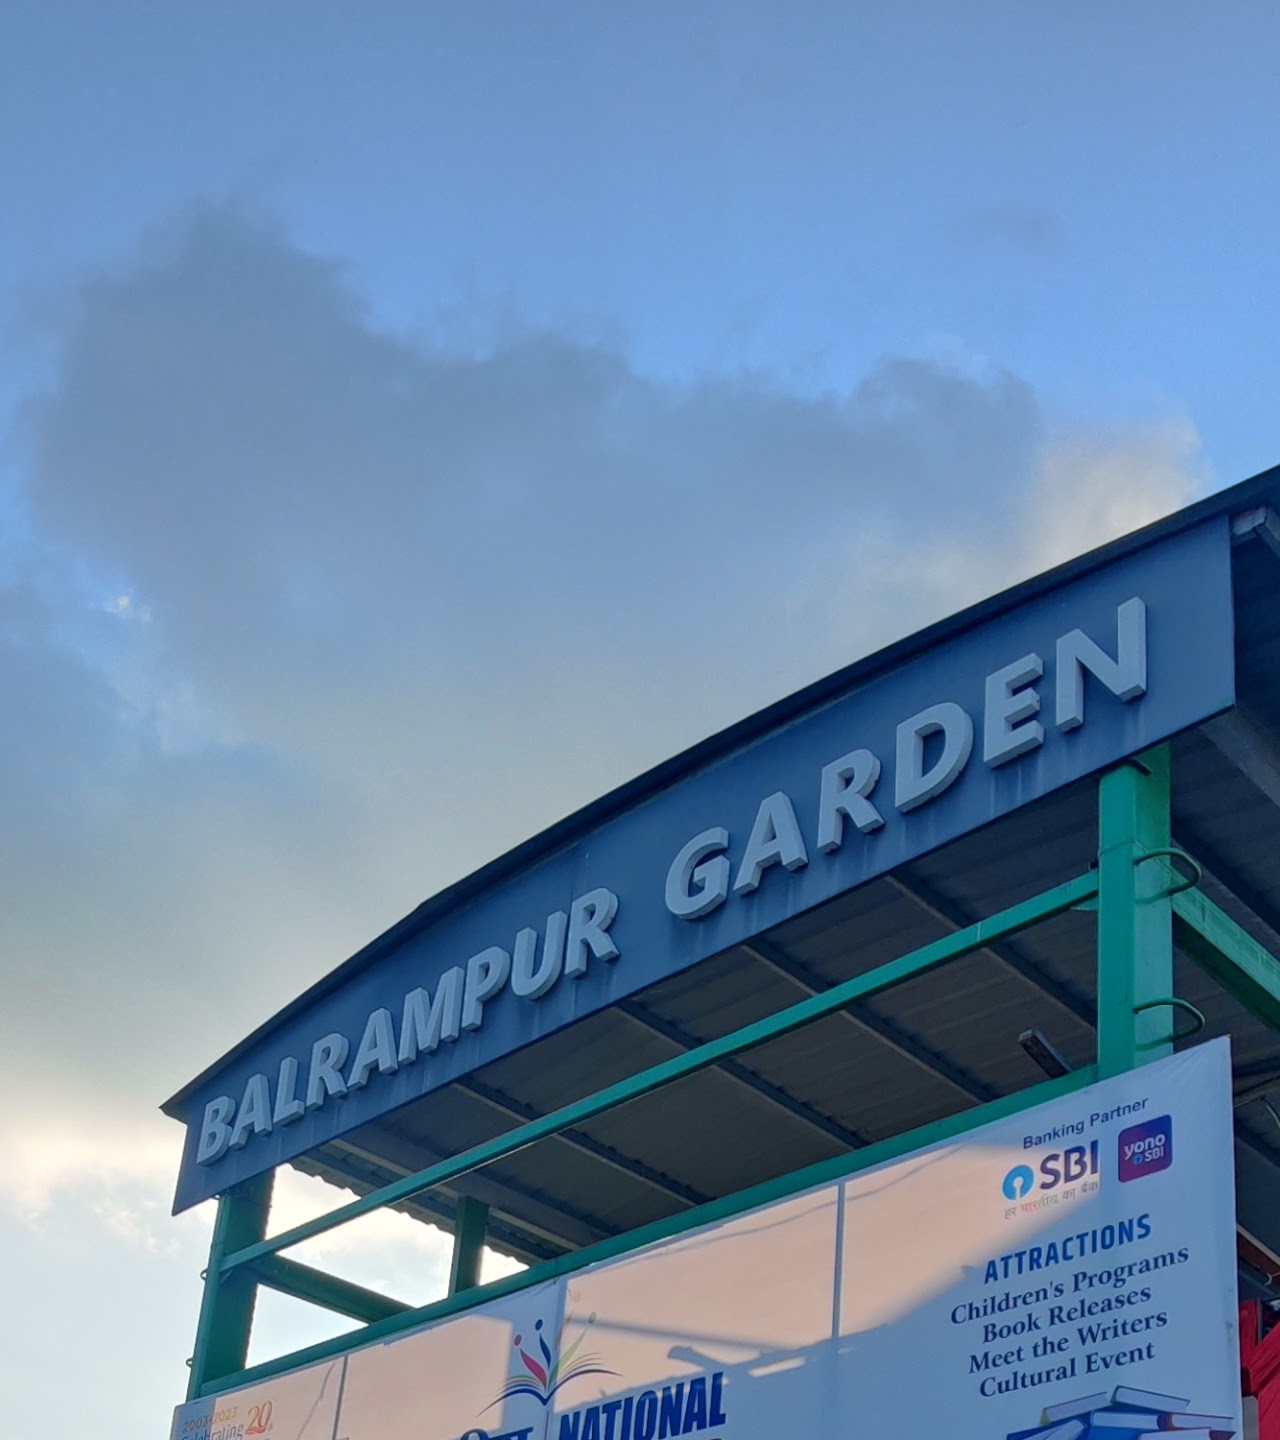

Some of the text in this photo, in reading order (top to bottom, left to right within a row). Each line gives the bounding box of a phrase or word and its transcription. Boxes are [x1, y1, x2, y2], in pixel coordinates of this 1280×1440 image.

[196, 596, 1146, 1166] BALRAMPUR GARDEN
[1023, 1098, 1149, 1150] Banking Partner
[1124, 1134, 1166, 1161] yono
[1039, 1139, 1099, 1190] SBI
[1144, 1146, 1164, 1162] SBI
[984, 1213, 1152, 1284] ATTRACTIONS
[951, 1247, 1189, 1324] Children's Programs
[968, 1311, 1168, 1374] Meet the Writers
[982, 1287, 1152, 1343] Book Releases
[979, 1342, 1155, 1397] Cultural Event
